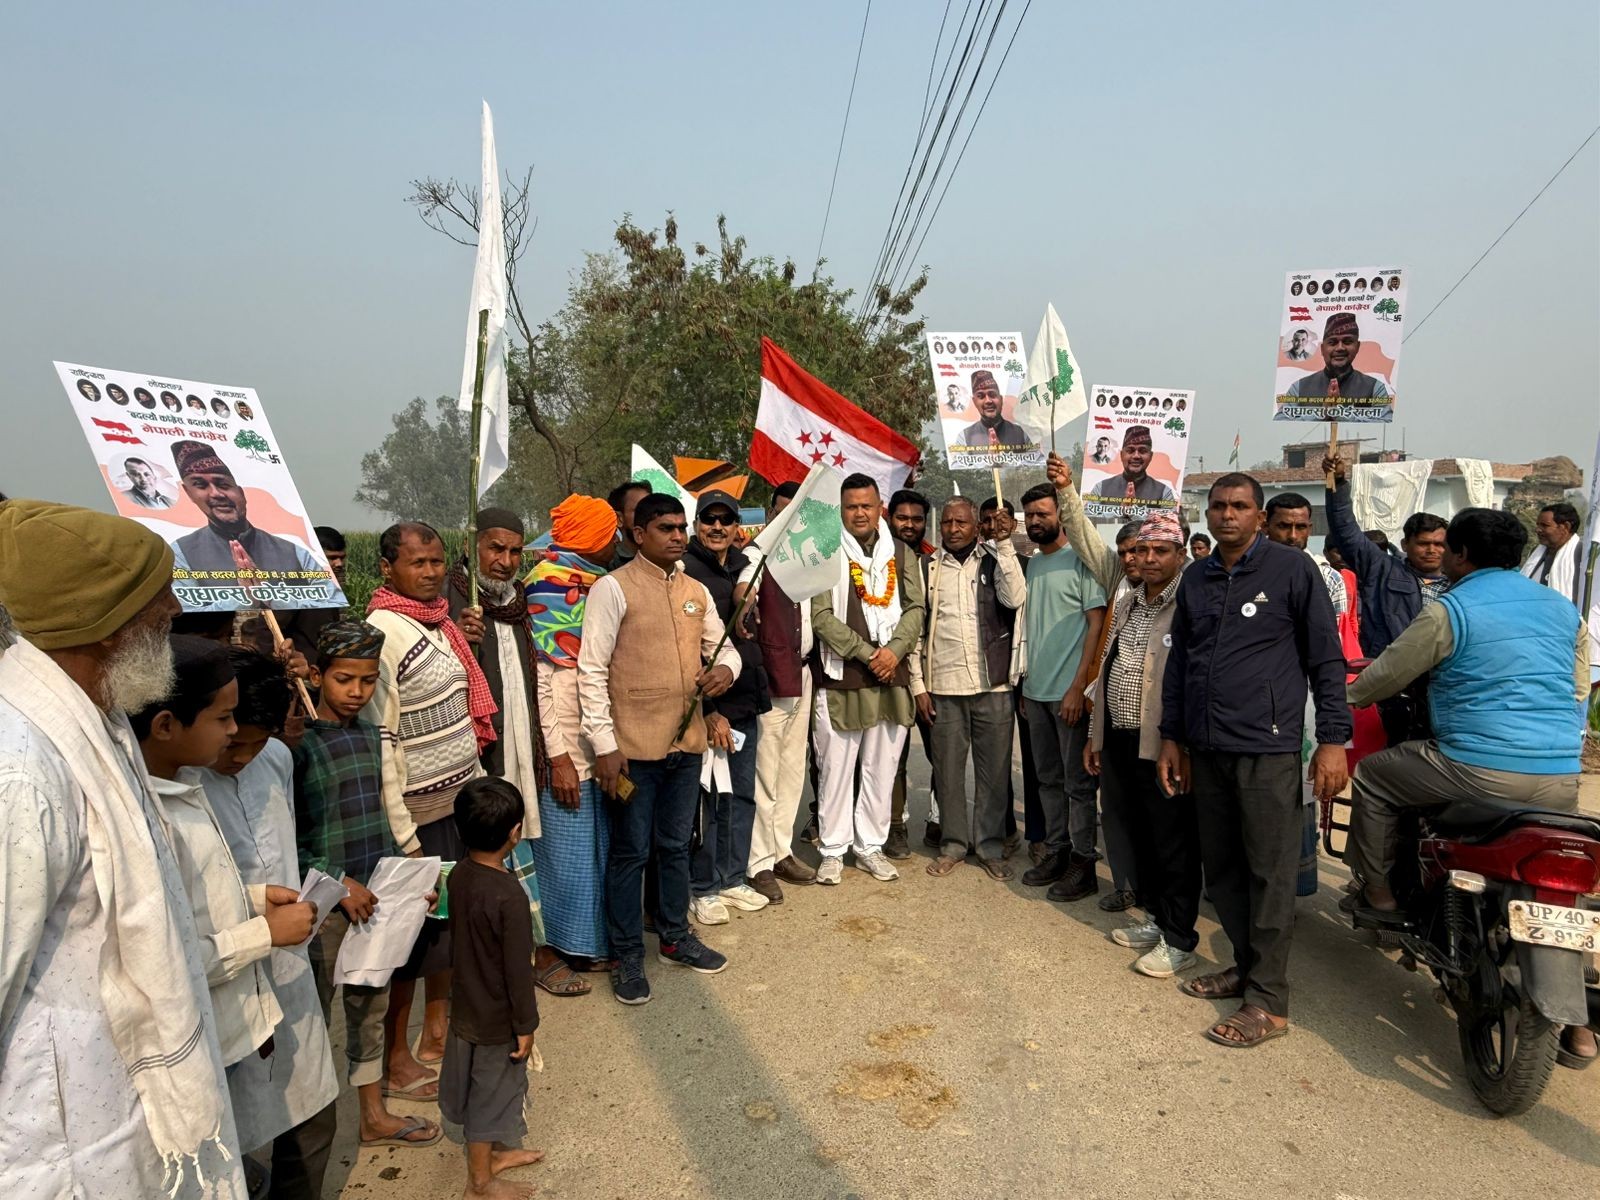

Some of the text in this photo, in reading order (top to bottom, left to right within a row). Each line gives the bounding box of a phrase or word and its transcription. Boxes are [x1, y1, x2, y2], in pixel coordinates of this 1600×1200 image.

[141, 423, 228, 442] नेपाली कांग्रेस
[191, 570, 209, 579] सभा
[209, 570, 236, 579] सदस्य
[1528, 926, 1545, 939] Z
